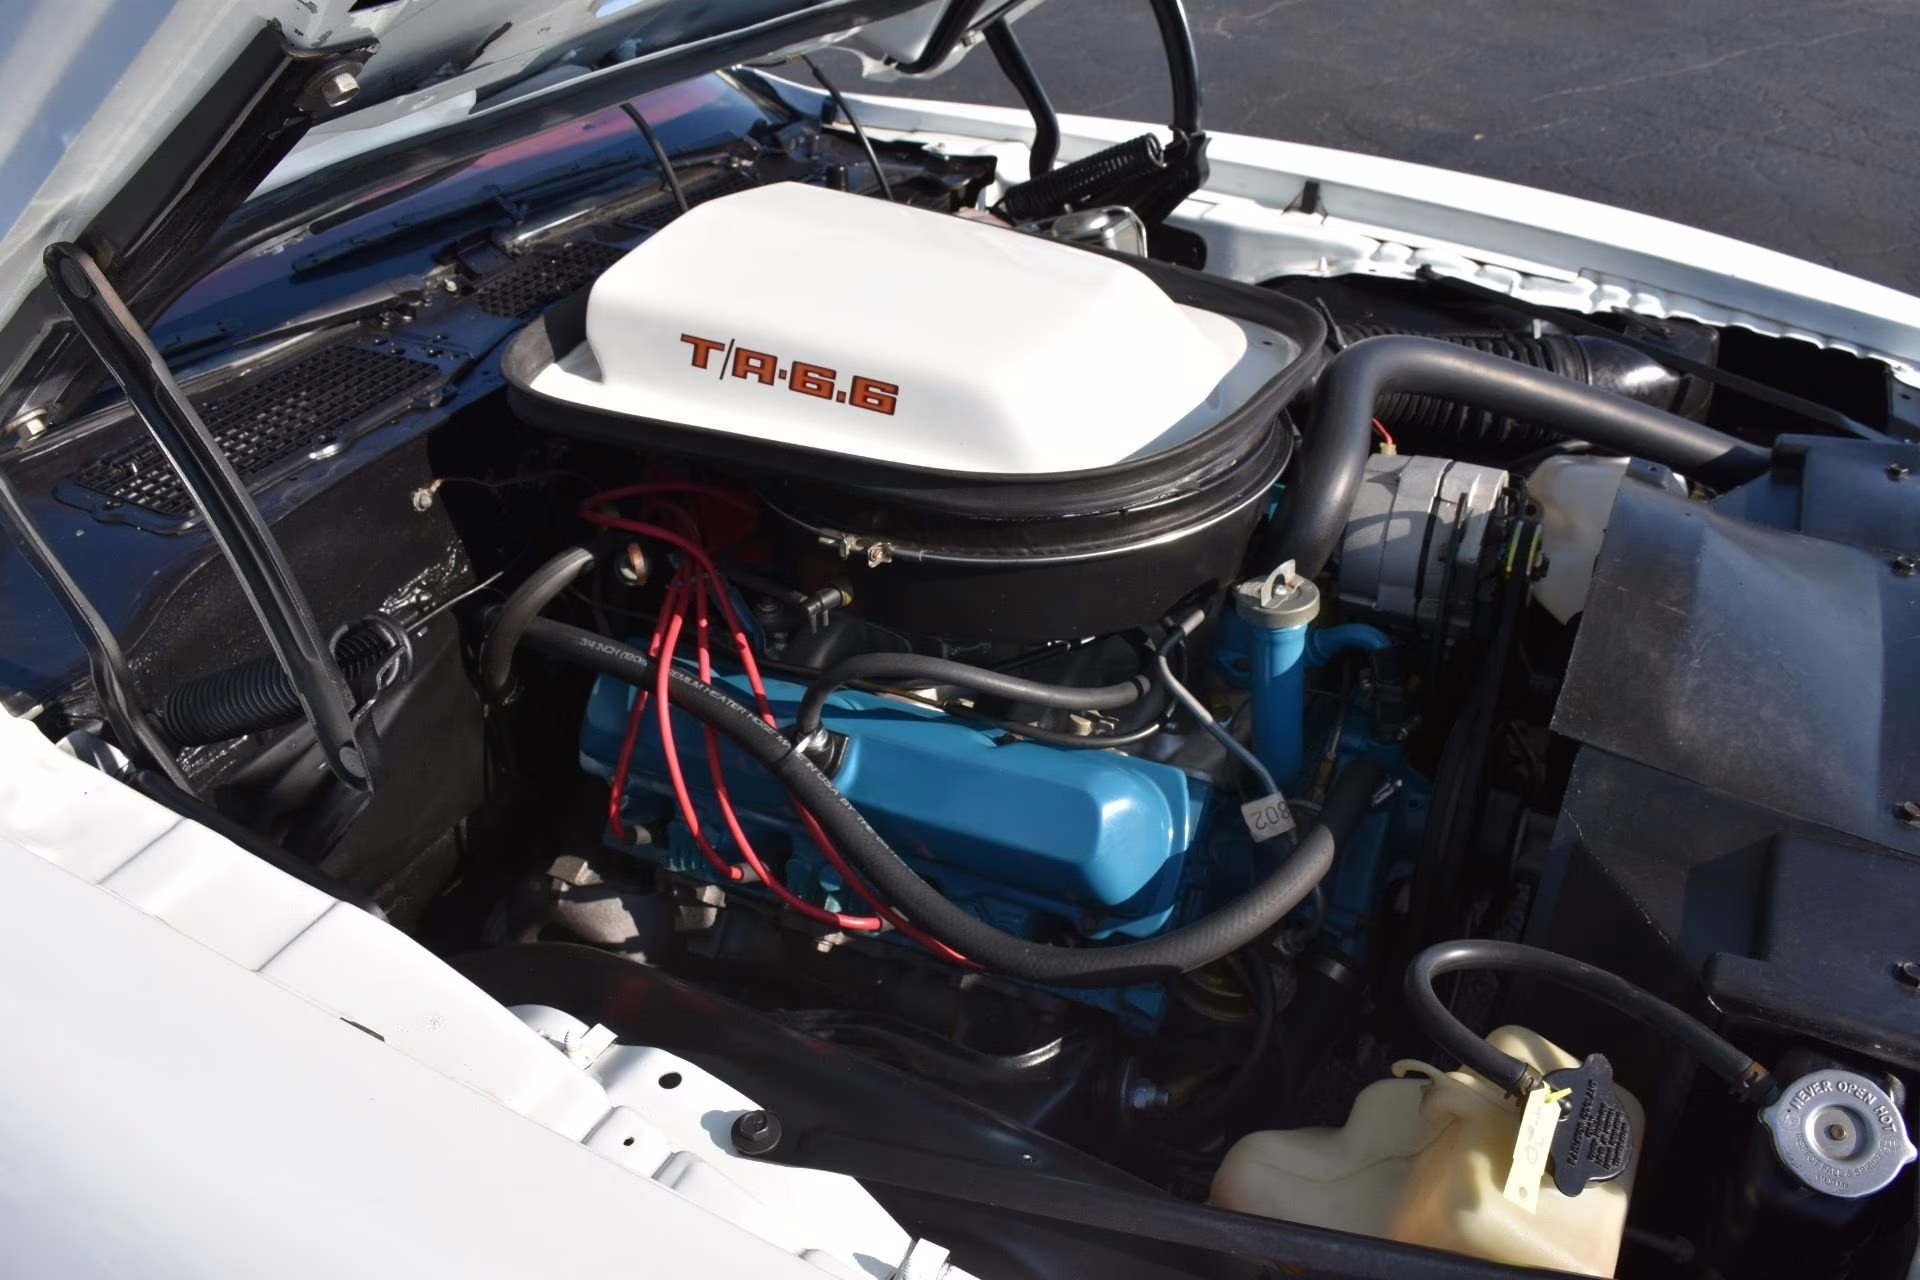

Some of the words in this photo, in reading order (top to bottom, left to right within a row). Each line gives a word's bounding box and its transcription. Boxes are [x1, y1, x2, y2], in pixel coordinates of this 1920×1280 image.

[668, 667, 704, 690] REMIUM
[703, 684, 747, 714] HEATER
[746, 712, 777, 736] HOSE
[816, 771, 839, 796] USA
[1789, 1080, 1833, 1111] NEVER
[1837, 1080, 1877, 1105] OPEN
[1874, 1104, 1897, 1134] HOT
[1819, 1162, 1844, 1178] FALL
